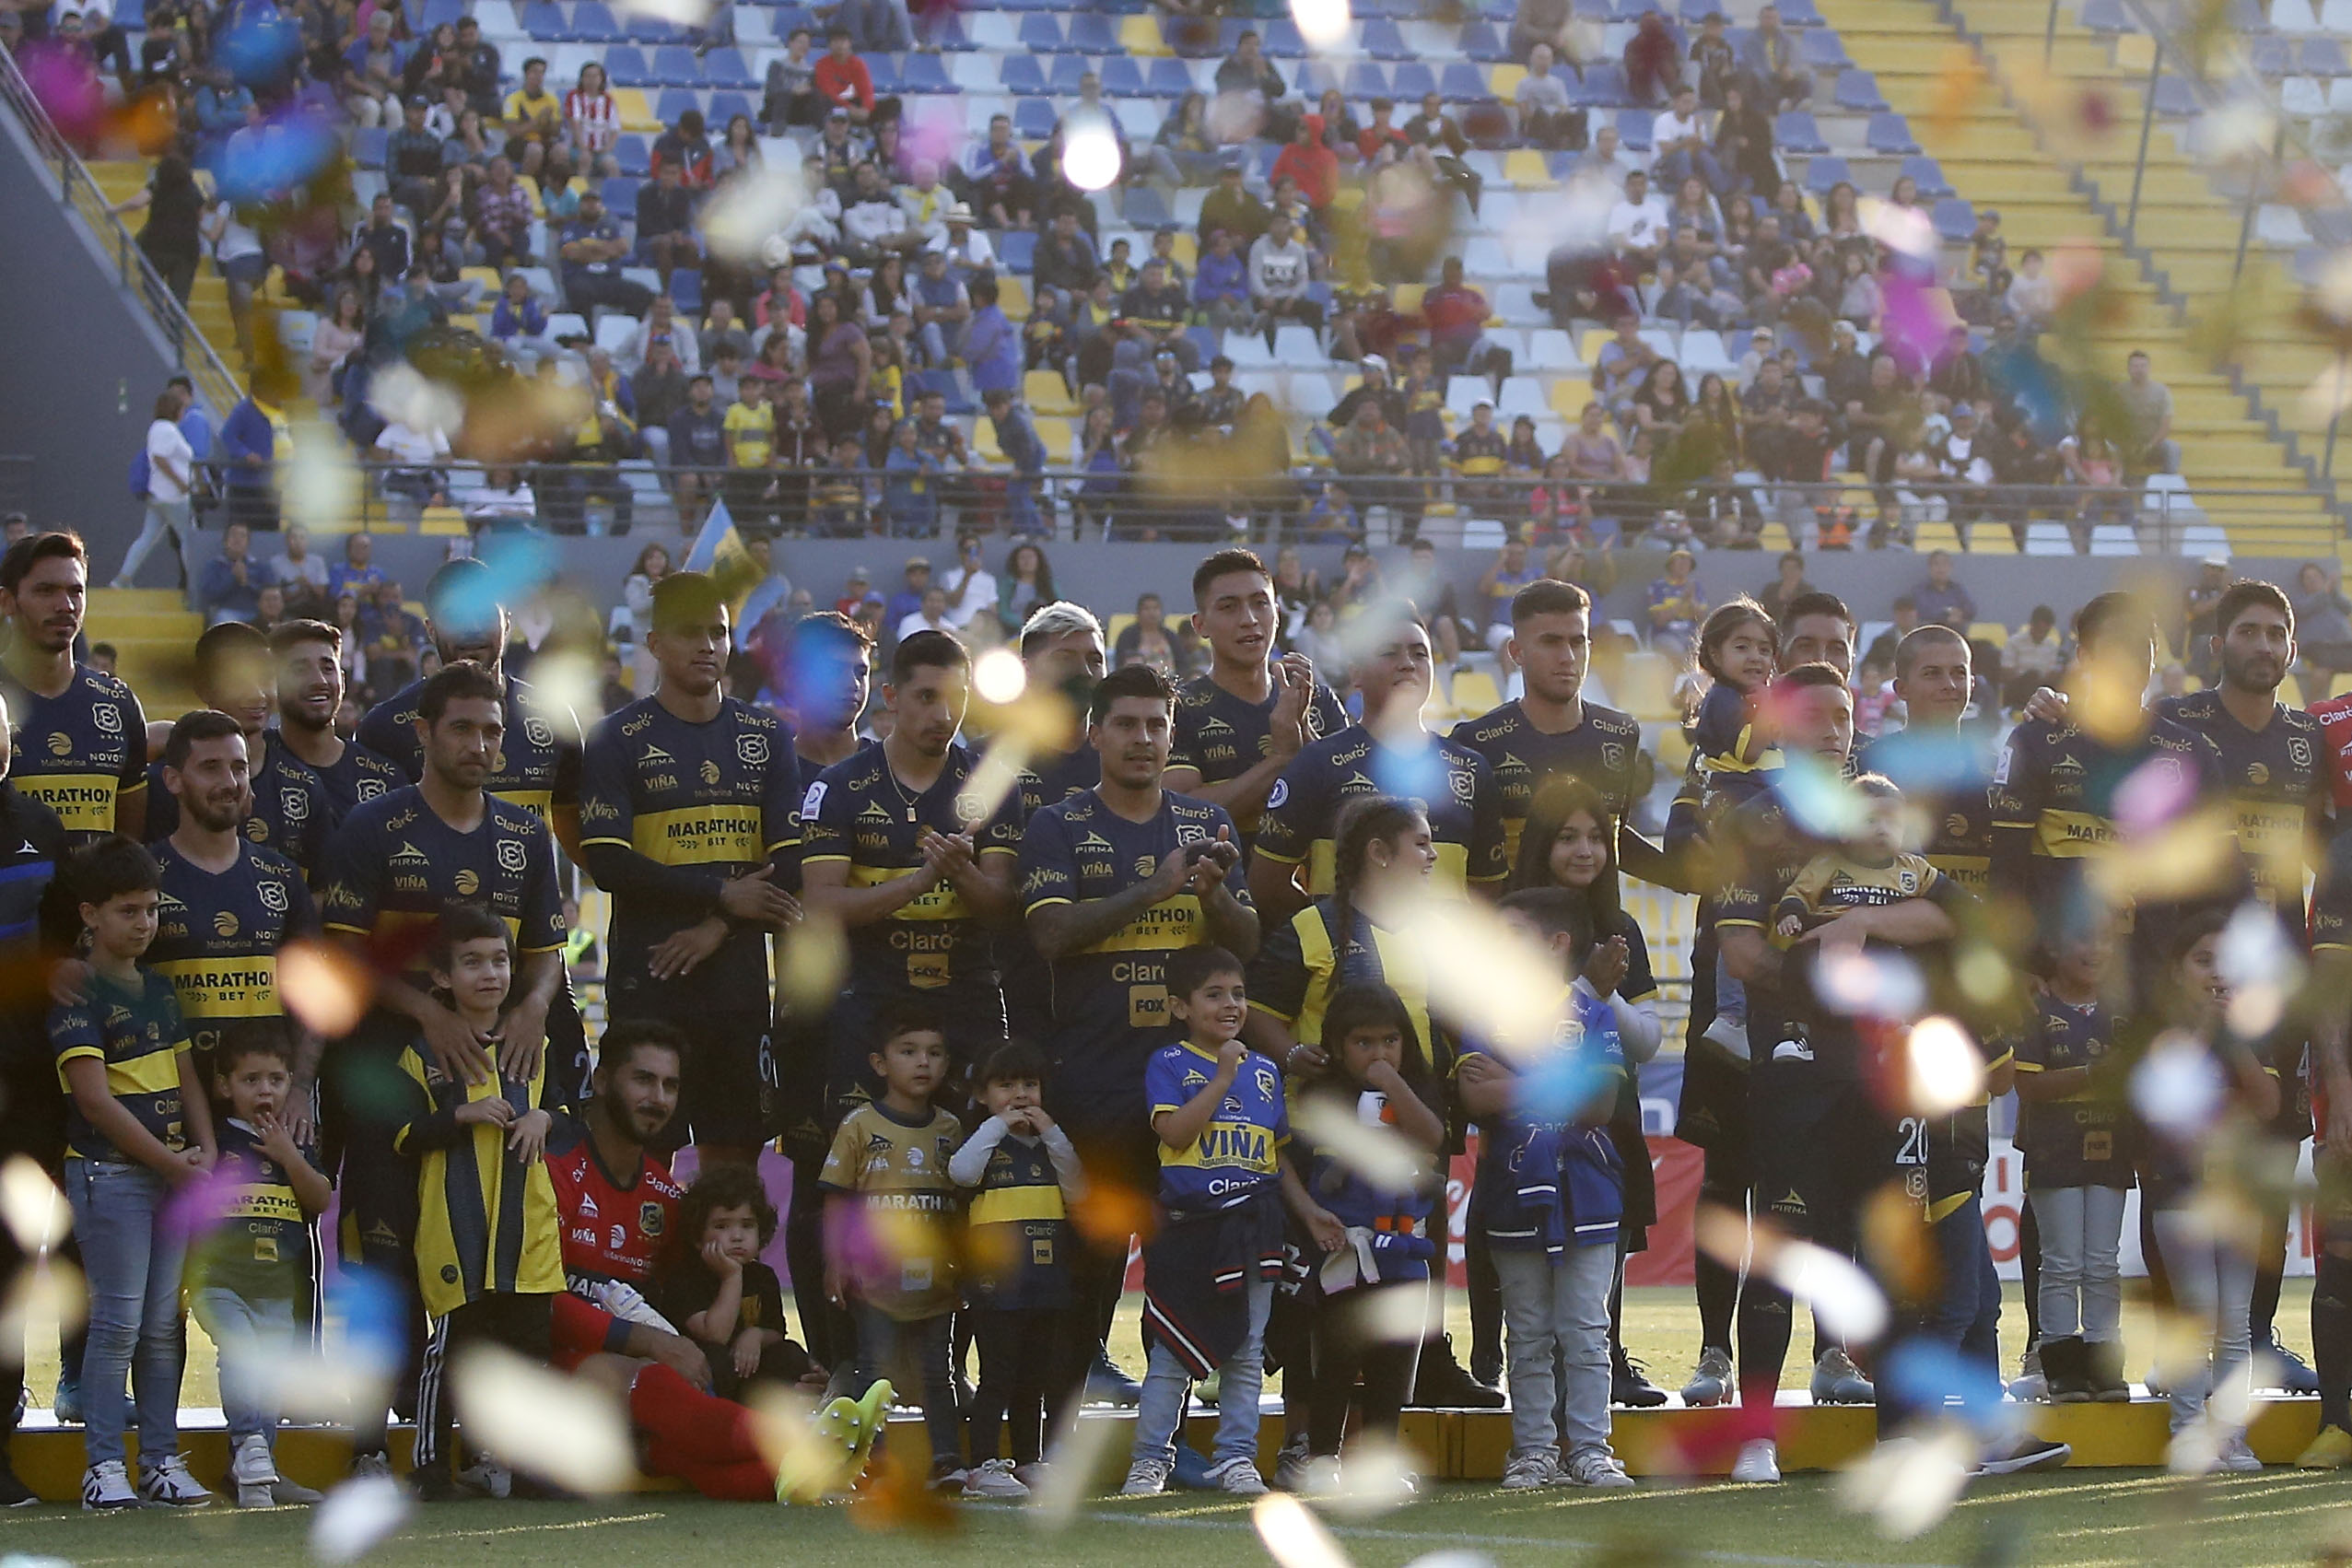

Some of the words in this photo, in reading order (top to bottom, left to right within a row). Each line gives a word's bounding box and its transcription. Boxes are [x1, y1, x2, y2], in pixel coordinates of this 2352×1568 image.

[86, 677, 125, 699] Claro
[393, 708, 422, 726] Cla
[621, 712, 654, 737] Claro
[735, 711, 778, 730] Claro
[1198, 727, 1236, 739] PIRMA
[1475, 718, 1519, 743] Claro
[1593, 718, 1635, 736] Claro
[2046, 723, 2080, 745] Claro
[1204, 744, 1237, 759] VIÑA
[2149, 734, 2194, 753] Claro
[1331, 742, 1371, 766] Claro
[638, 757, 677, 770] PIRMA
[1493, 766, 1533, 776] PIRMA
[645, 774, 679, 790] VIÑA
[848, 767, 882, 791] Claro
[1017, 776, 1044, 785] RMA
[1341, 785, 1380, 794] PIRMA
[55, 806, 82, 815] BET
[1171, 804, 1215, 820] Claro
[385, 808, 418, 832] Claro
[494, 814, 537, 836] Claro
[855, 816, 895, 826] PIRMA
[668, 819, 757, 838] MARATHON
[857, 832, 891, 848] VIÑA
[1075, 845, 1115, 855] PIRMA
[250, 856, 292, 878] Claro
[389, 856, 430, 868] PIRMA
[1082, 860, 1114, 876] VIÑA
[393, 874, 428, 889] VIÑA
[913, 896, 941, 906] BET
[160, 904, 189, 915] RMA
[1132, 907, 1195, 923] ATHON
[889, 924, 956, 952] Claro
[1136, 926, 1160, 935] BET
[218, 991, 246, 1001] BET
[1135, 999, 1165, 1013] FOX
[155, 1098, 183, 1116] Clar
[2075, 1109, 2117, 1125] Claro
[1199, 1124, 1269, 1164] VIÑA
[1895, 1116, 1930, 1164] 20
[645, 1171, 686, 1200] Claro
[1209, 1176, 1261, 1196] Claro
[867, 1194, 954, 1211] MARATH
[1771, 1202, 1808, 1216] PIRMA
[248, 1222, 283, 1235] Claro
[571, 1228, 598, 1245] VIÑA
[1024, 1223, 1056, 1236] Claro
